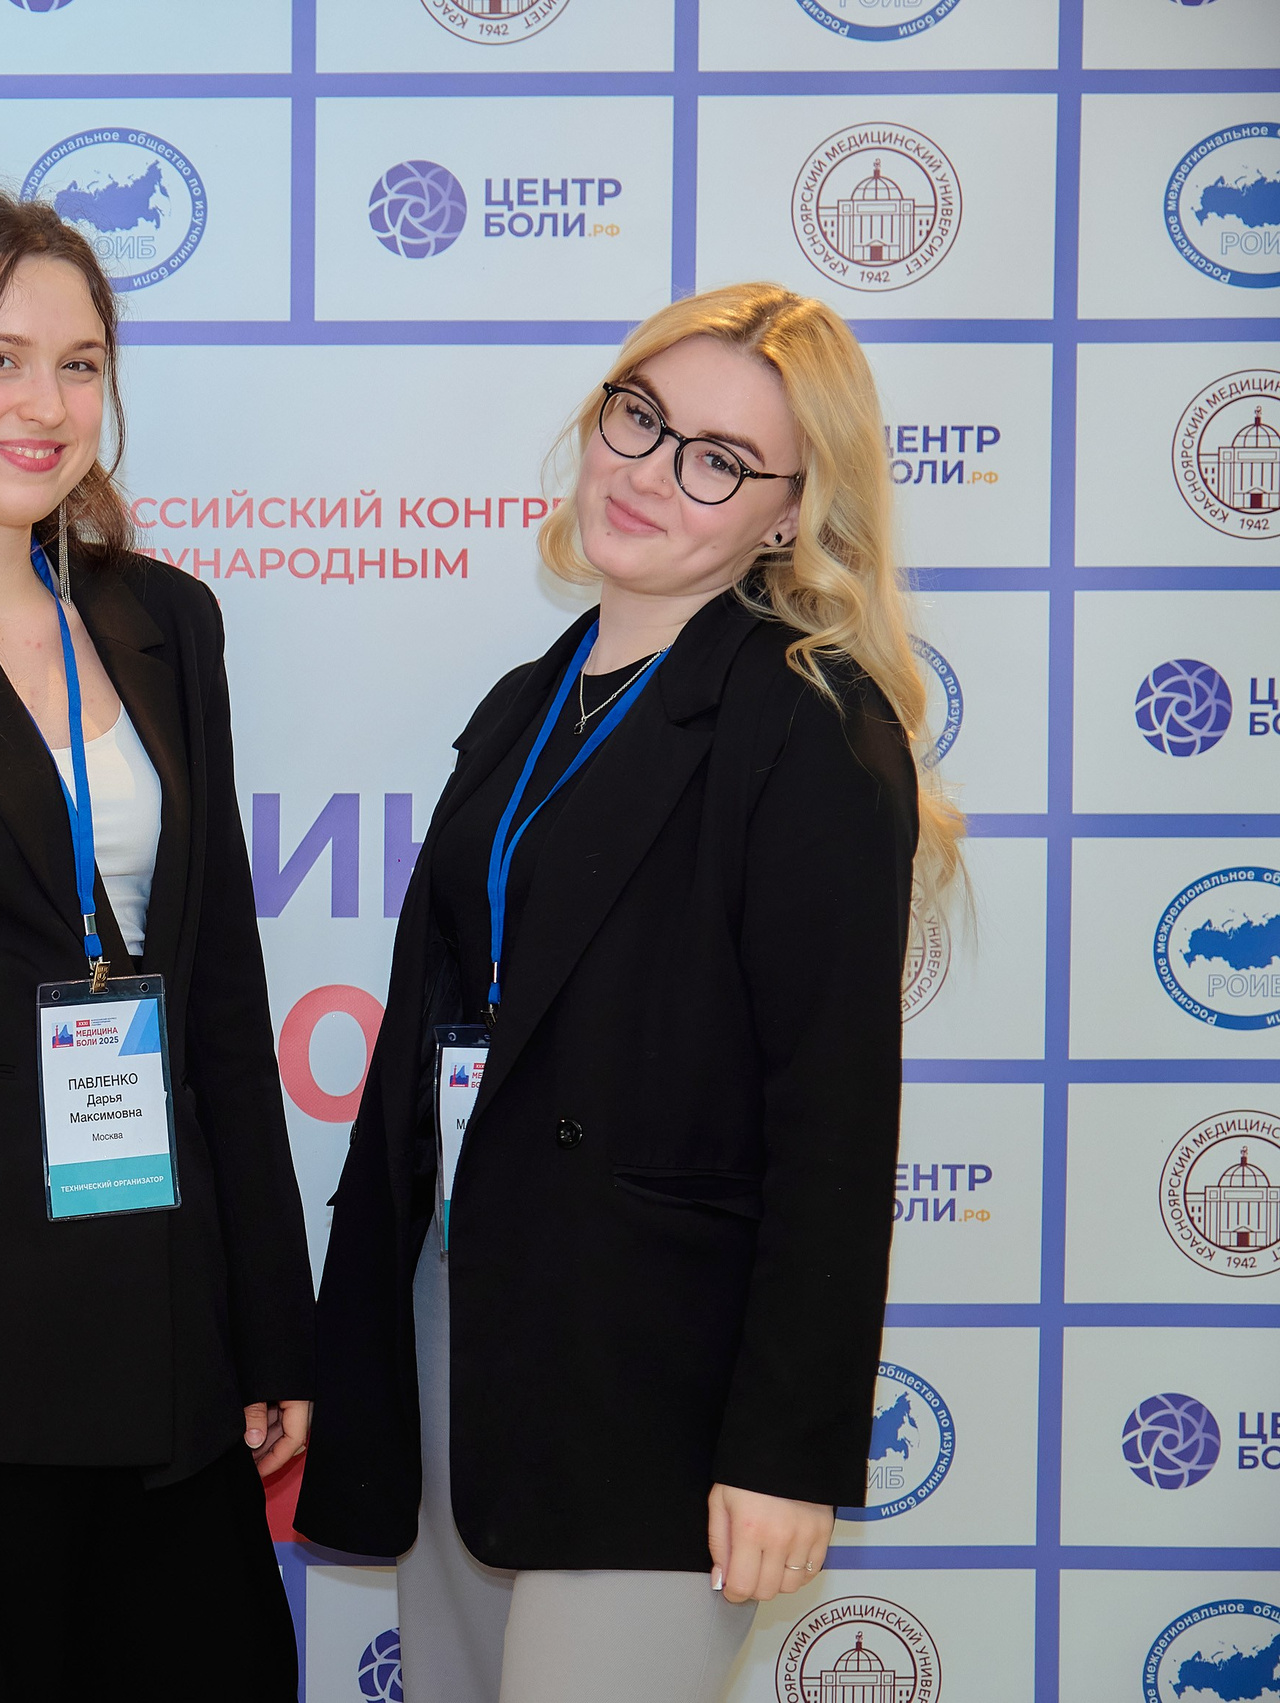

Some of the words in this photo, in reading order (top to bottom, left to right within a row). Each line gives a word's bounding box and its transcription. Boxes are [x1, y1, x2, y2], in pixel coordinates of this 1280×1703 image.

[479, 24, 509, 35] 1942
[899, 14, 935, 35] боли
[128, 133, 191, 176] общество
[1168, 127, 1268, 210] межрегиональное
[188, 178, 201, 196] по
[484, 178, 622, 211] ЦЕНТР
[800, 159, 849, 277] КРАСНОЯРСКИЙ
[825, 131, 943, 173] МЕДИЦИНСКИЙ
[905, 173, 953, 276] УНИВЕРСИТЕТ
[169, 201, 203, 268] изучению
[1221, 231, 1280, 255] РОИ
[94, 236, 156, 259] ОИБ
[1169, 216, 1232, 284] Российское
[133, 266, 169, 287] боли
[860, 271, 890, 283] 1942
[890, 459, 999, 484] ОЛИ.РФ
[1181, 406, 1230, 524] КРАСНОЯРСКИЙ
[129, 488, 382, 529] ССИЙСКИЙ
[400, 497, 565, 528] КОНГР
[1239, 518, 1270, 530] 1942
[945, 676, 957, 694] по
[1158, 870, 1254, 953] межрегиональное
[902, 916, 941, 1012] УНИВЕРСИТЕ
[1158, 958, 1218, 1025] Российское
[76, 1027, 118, 1037] МЕДИЦИНА
[76, 1039, 98, 1047] БОЛИ
[99, 1036, 119, 1045] 2025
[68, 1072, 138, 1090] ПАВЛЕНКО
[86, 1094, 123, 1107] Дарья
[69, 1108, 142, 1123] Максимовна
[92, 1132, 123, 1141] Москва
[60, 1179, 112, 1193] ТЕХНИЧЕСКИЙ
[113, 1175, 164, 1187] ОРГАНИЗАТОР
[895, 1164, 993, 1191] ЕНТР
[1168, 1145, 1216, 1261] КРАСНОЯРСКИЙ
[1193, 1119, 1280, 1148] МЕДИЦИНС
[1226, 1256, 1257, 1268] 1942
[878, 1365, 940, 1407] общество
[937, 1409, 950, 1427] по
[918, 1432, 951, 1498] изучению
[867, 1466, 905, 1489] ИБ
[881, 1496, 916, 1516] боли
[785, 1631, 811, 1703] ОЯРСКИЙ
[809, 1604, 923, 1645] МЕДИЦИНСКИЙ
[1147, 1603, 1244, 1684] межрегиональное
